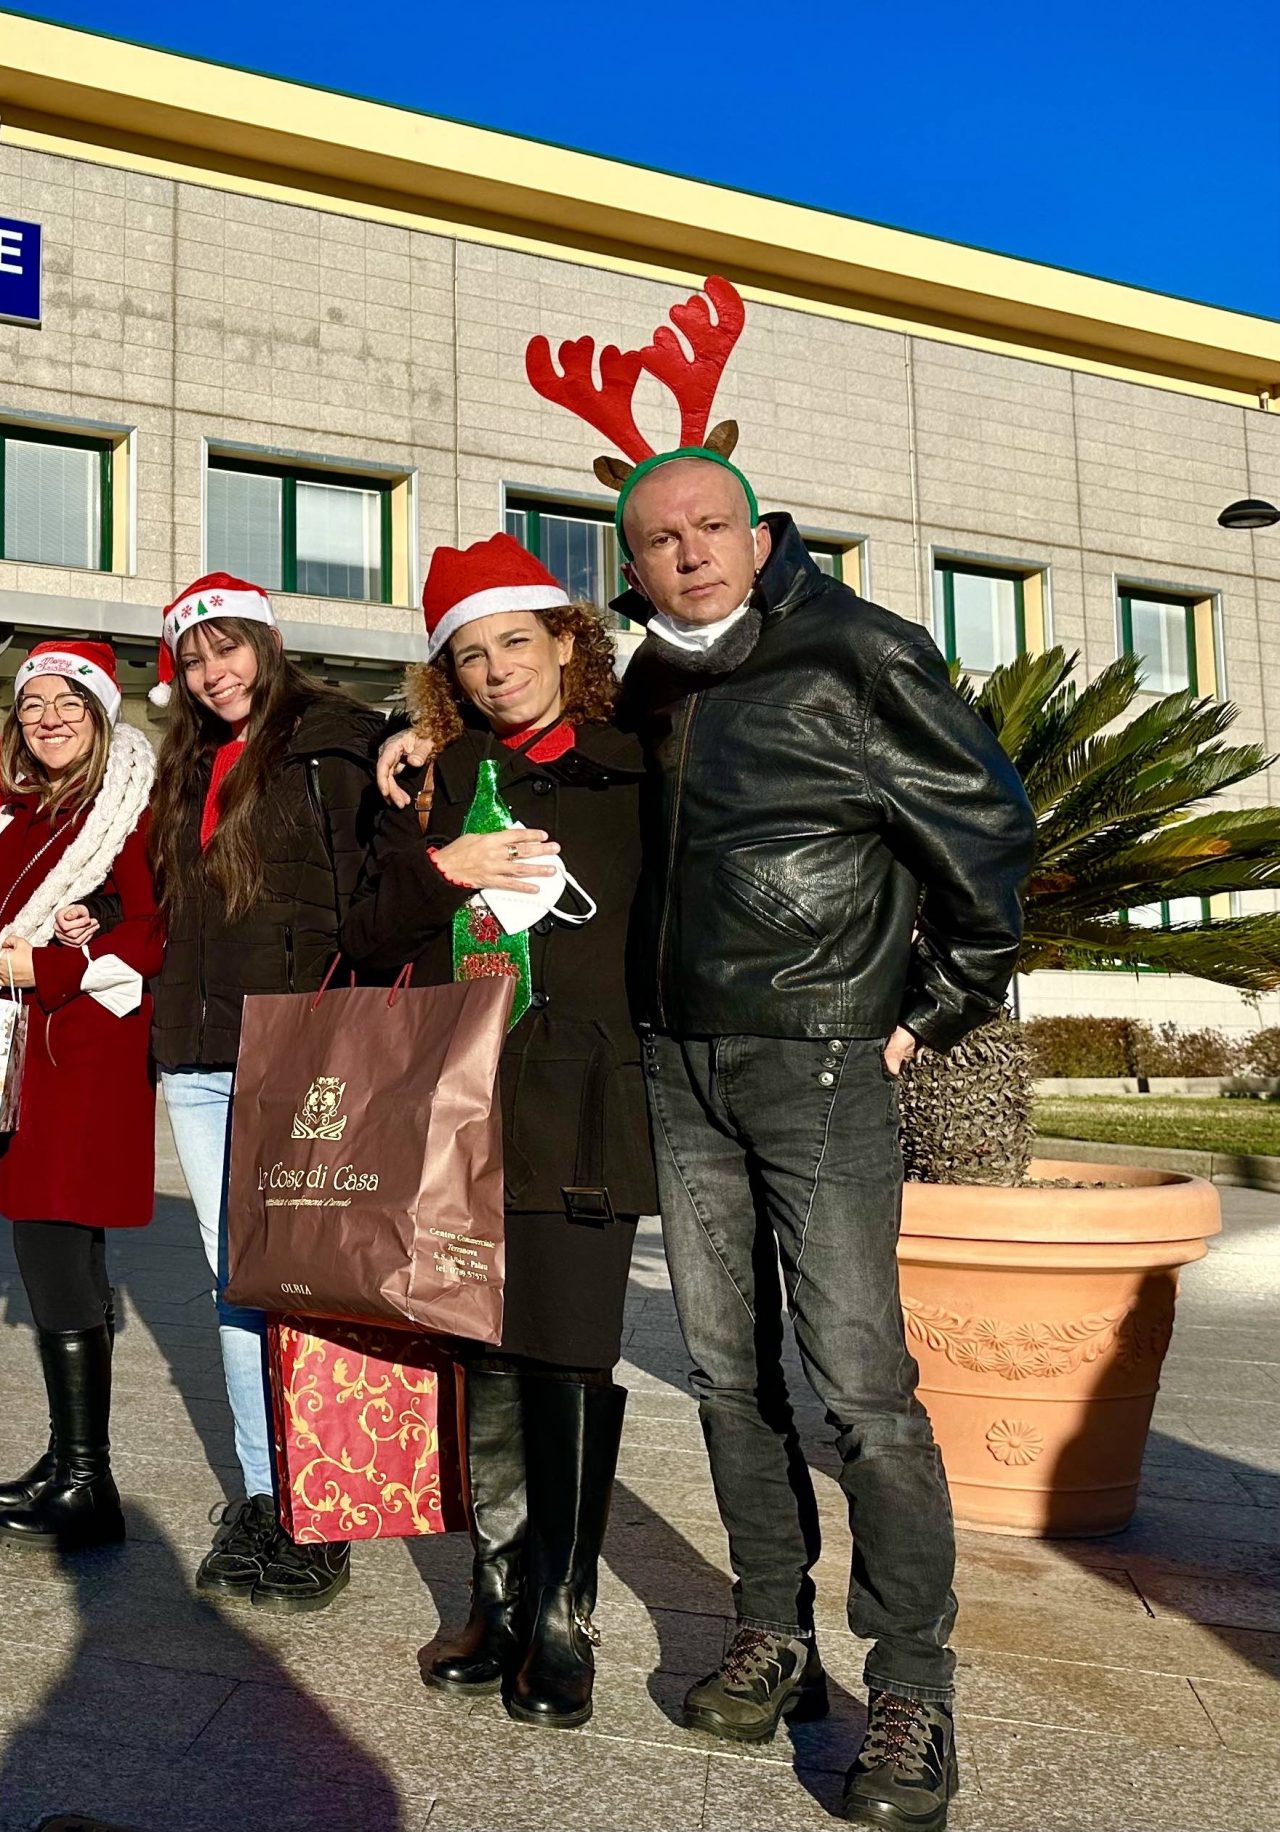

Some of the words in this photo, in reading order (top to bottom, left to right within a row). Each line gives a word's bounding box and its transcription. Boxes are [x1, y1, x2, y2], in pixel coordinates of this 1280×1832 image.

[41, 657, 72, 667] Merry
[269, 1161, 305, 1191] Cose
[306, 1163, 328, 1189] di
[333, 1164, 379, 1191] Casa
[429, 1228, 456, 1239] Centro
[457, 1234, 495, 1248] Commerciale
[448, 1243, 477, 1256] Terranova
[281, 1283, 312, 1295] OLBIA
